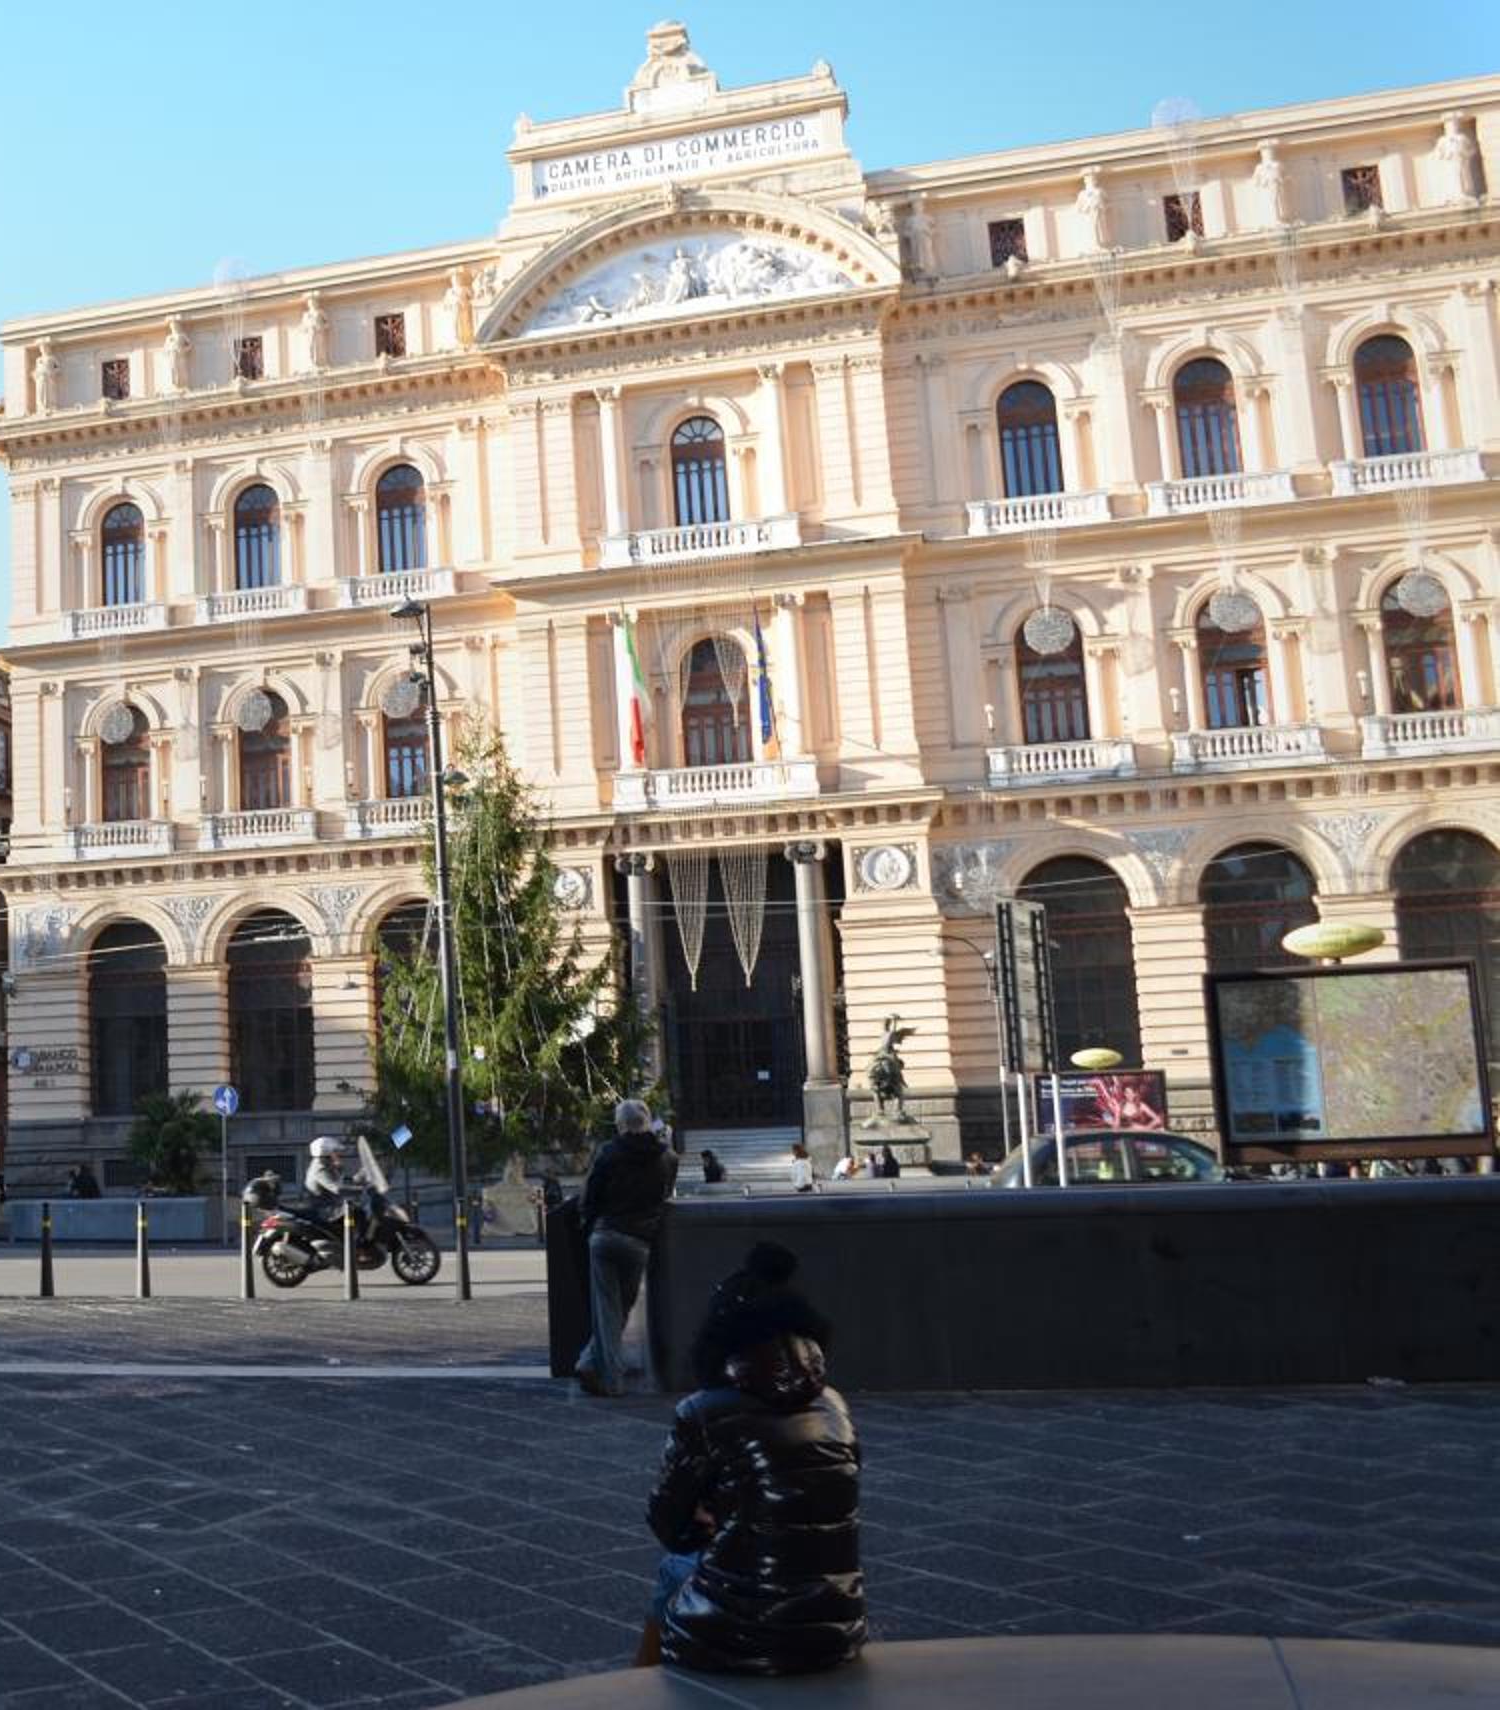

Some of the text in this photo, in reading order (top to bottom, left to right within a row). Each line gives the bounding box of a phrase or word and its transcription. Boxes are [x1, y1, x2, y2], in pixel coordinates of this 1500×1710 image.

[535, 175, 605, 198] INDUSTRIA
[615, 159, 699, 182] ARTIGIANATO
[727, 138, 819, 162] AGRICOLTURA
[548, 120, 805, 180] CAMERA DI COMMERCIO
